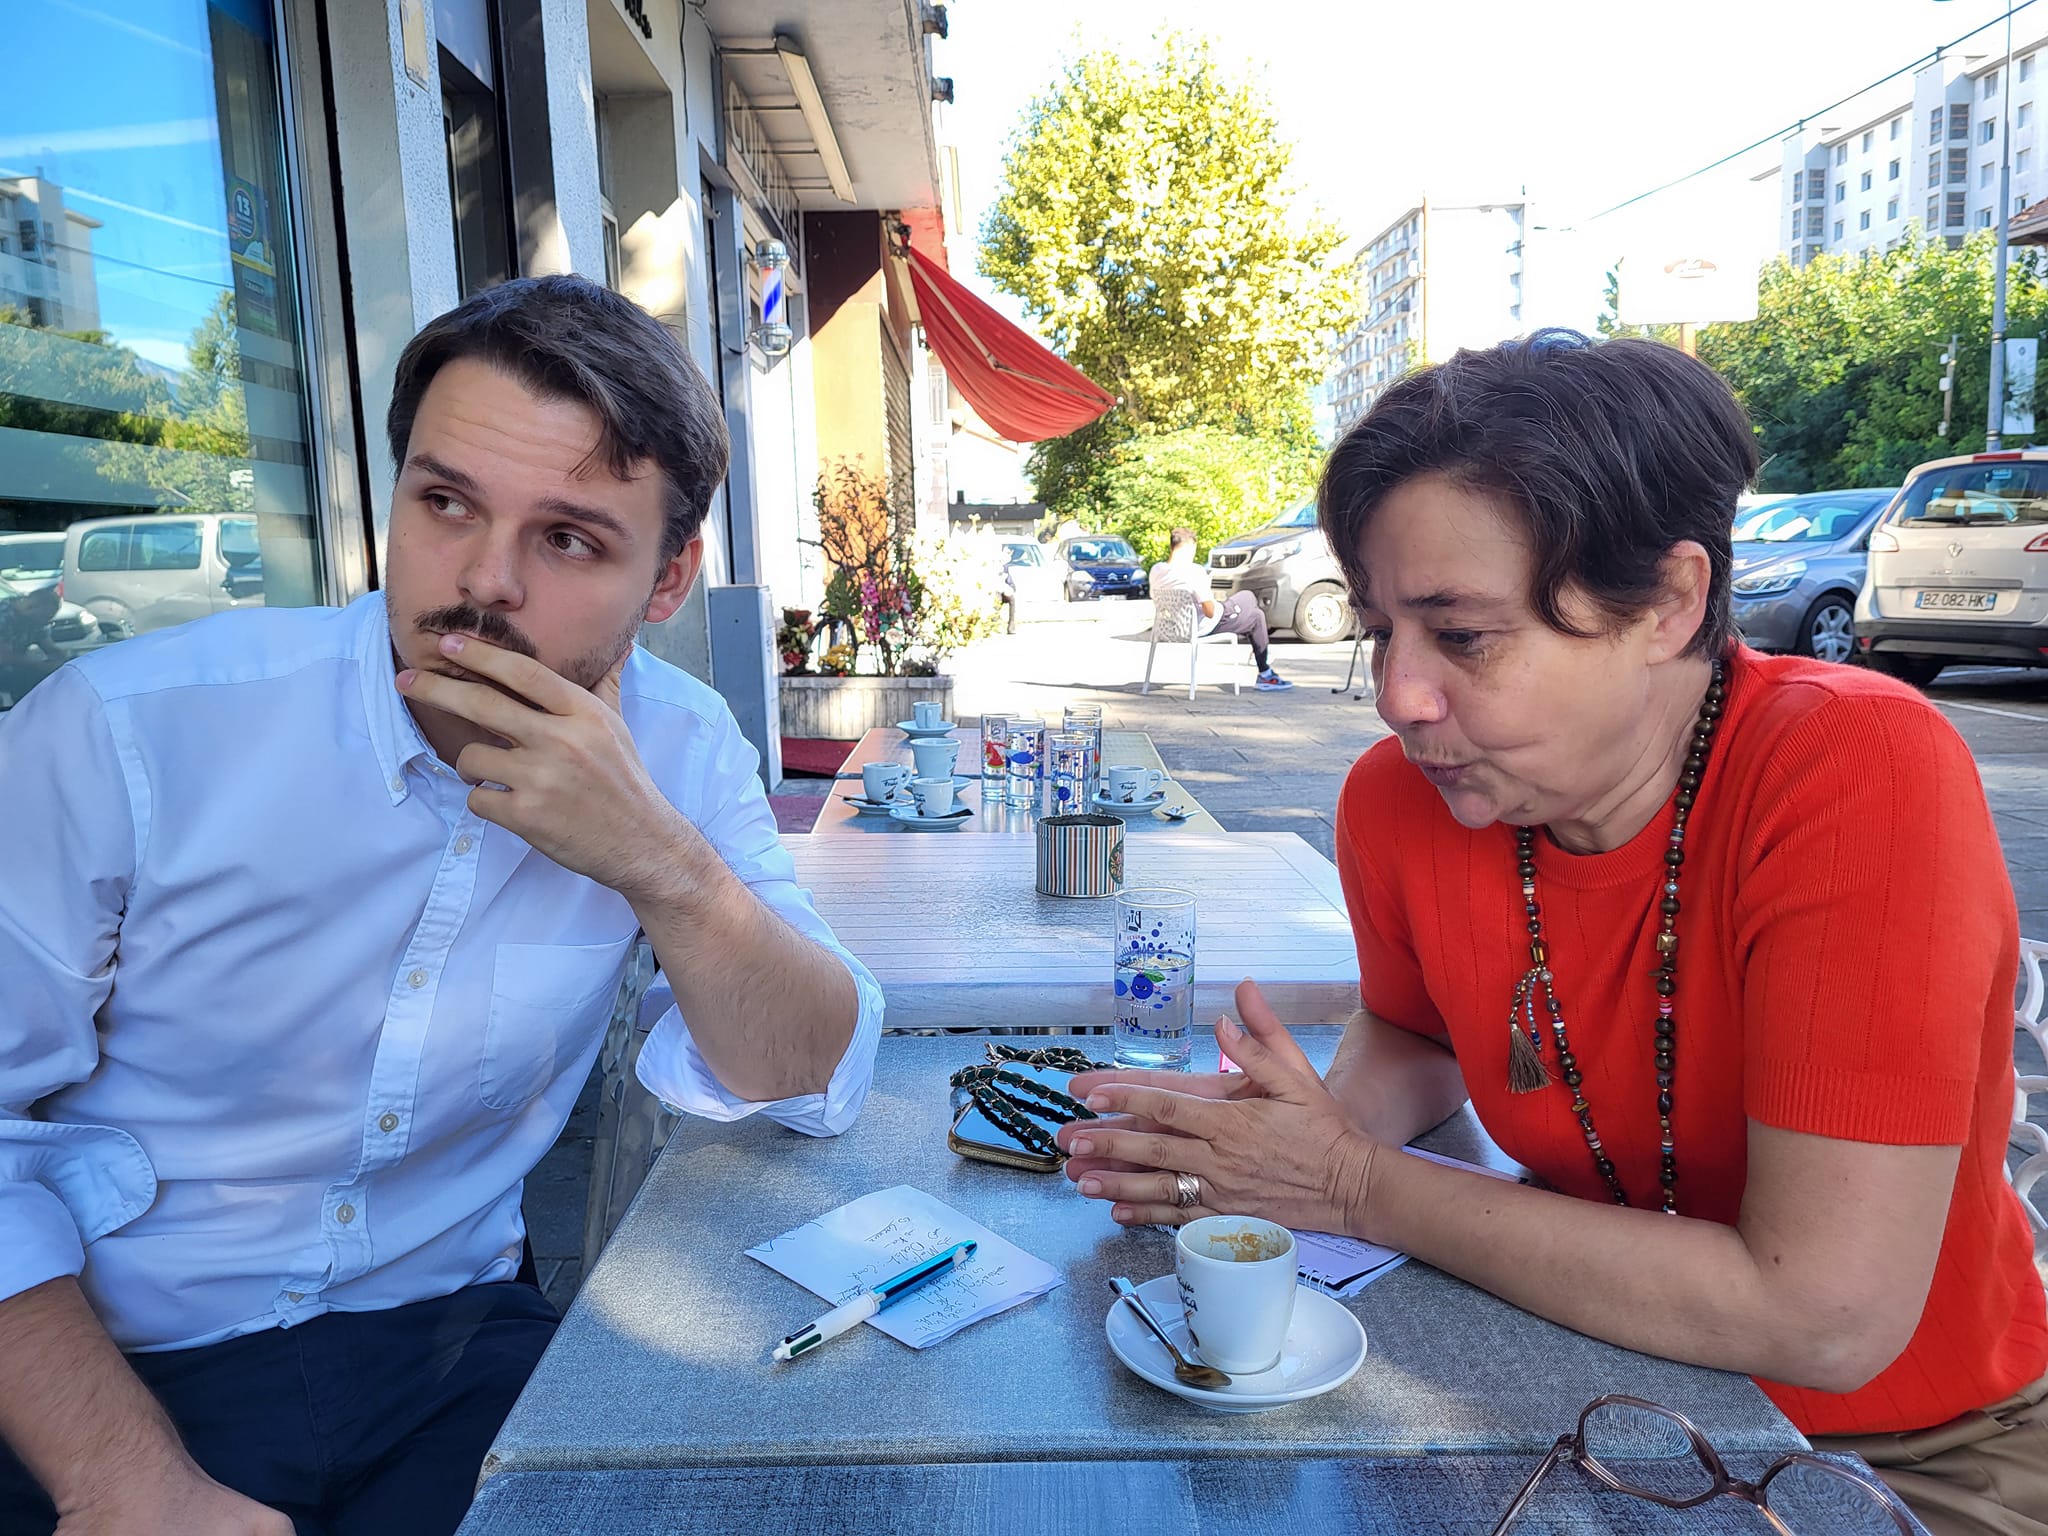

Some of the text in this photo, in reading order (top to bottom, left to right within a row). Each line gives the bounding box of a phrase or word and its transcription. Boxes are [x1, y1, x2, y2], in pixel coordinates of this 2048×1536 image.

[236, 194, 251, 217] 13
[1923, 593, 1986, 607] BZ 082 HK
